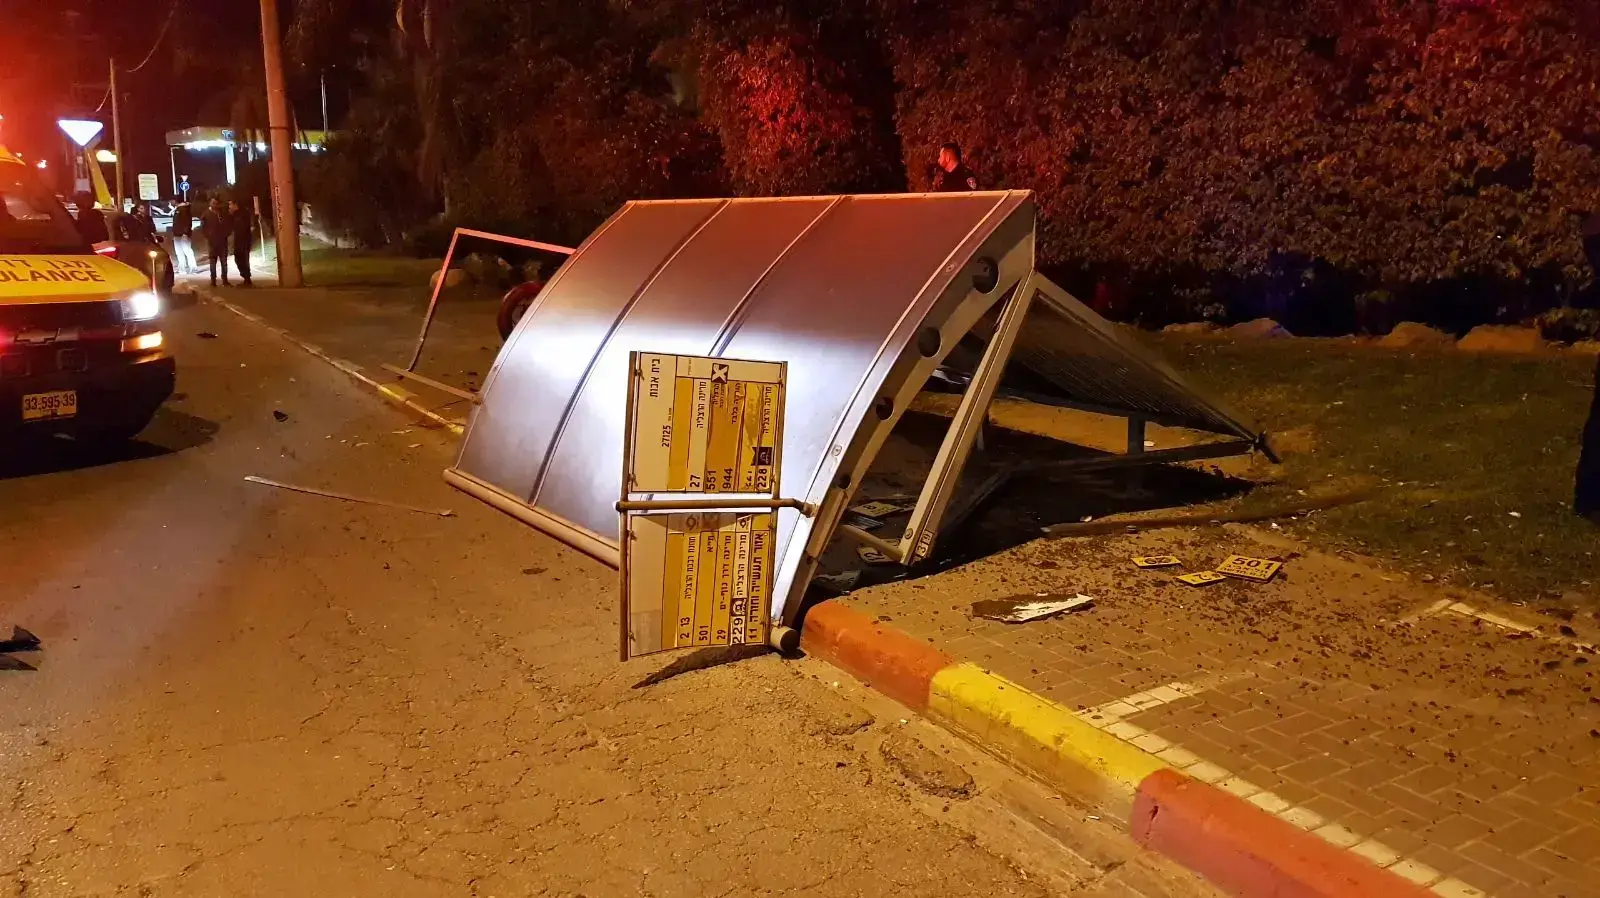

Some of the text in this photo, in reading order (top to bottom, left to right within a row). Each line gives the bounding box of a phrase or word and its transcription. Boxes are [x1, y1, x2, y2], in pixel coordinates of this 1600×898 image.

[649, 358, 661, 398] בית אבות
[696, 381, 707, 429] מרינה הרצליה
[761, 386, 772, 434] מרינה הרצליה
[661, 424, 672, 448] 27125
[690, 474, 701, 488] 27
[706, 470, 717, 490] 551
[722, 467, 734, 489] 944
[757, 468, 768, 488] 228
[723, 535, 731, 560] מרינה
[738, 534, 747, 559] מרינה
[753, 533, 764, 553] אזור
[721, 564, 730, 579] דרך
[1232, 557, 1275, 570] 501
[684, 574, 693, 599] הרצליה
[736, 564, 745, 596] הרצליה
[749, 595, 760, 622] וחזרה
[680, 617, 690, 627] 13
[699, 625, 709, 641] 501
[732, 617, 744, 644] 229
[716, 629, 726, 640] 29
[748, 628, 757, 639] 11
